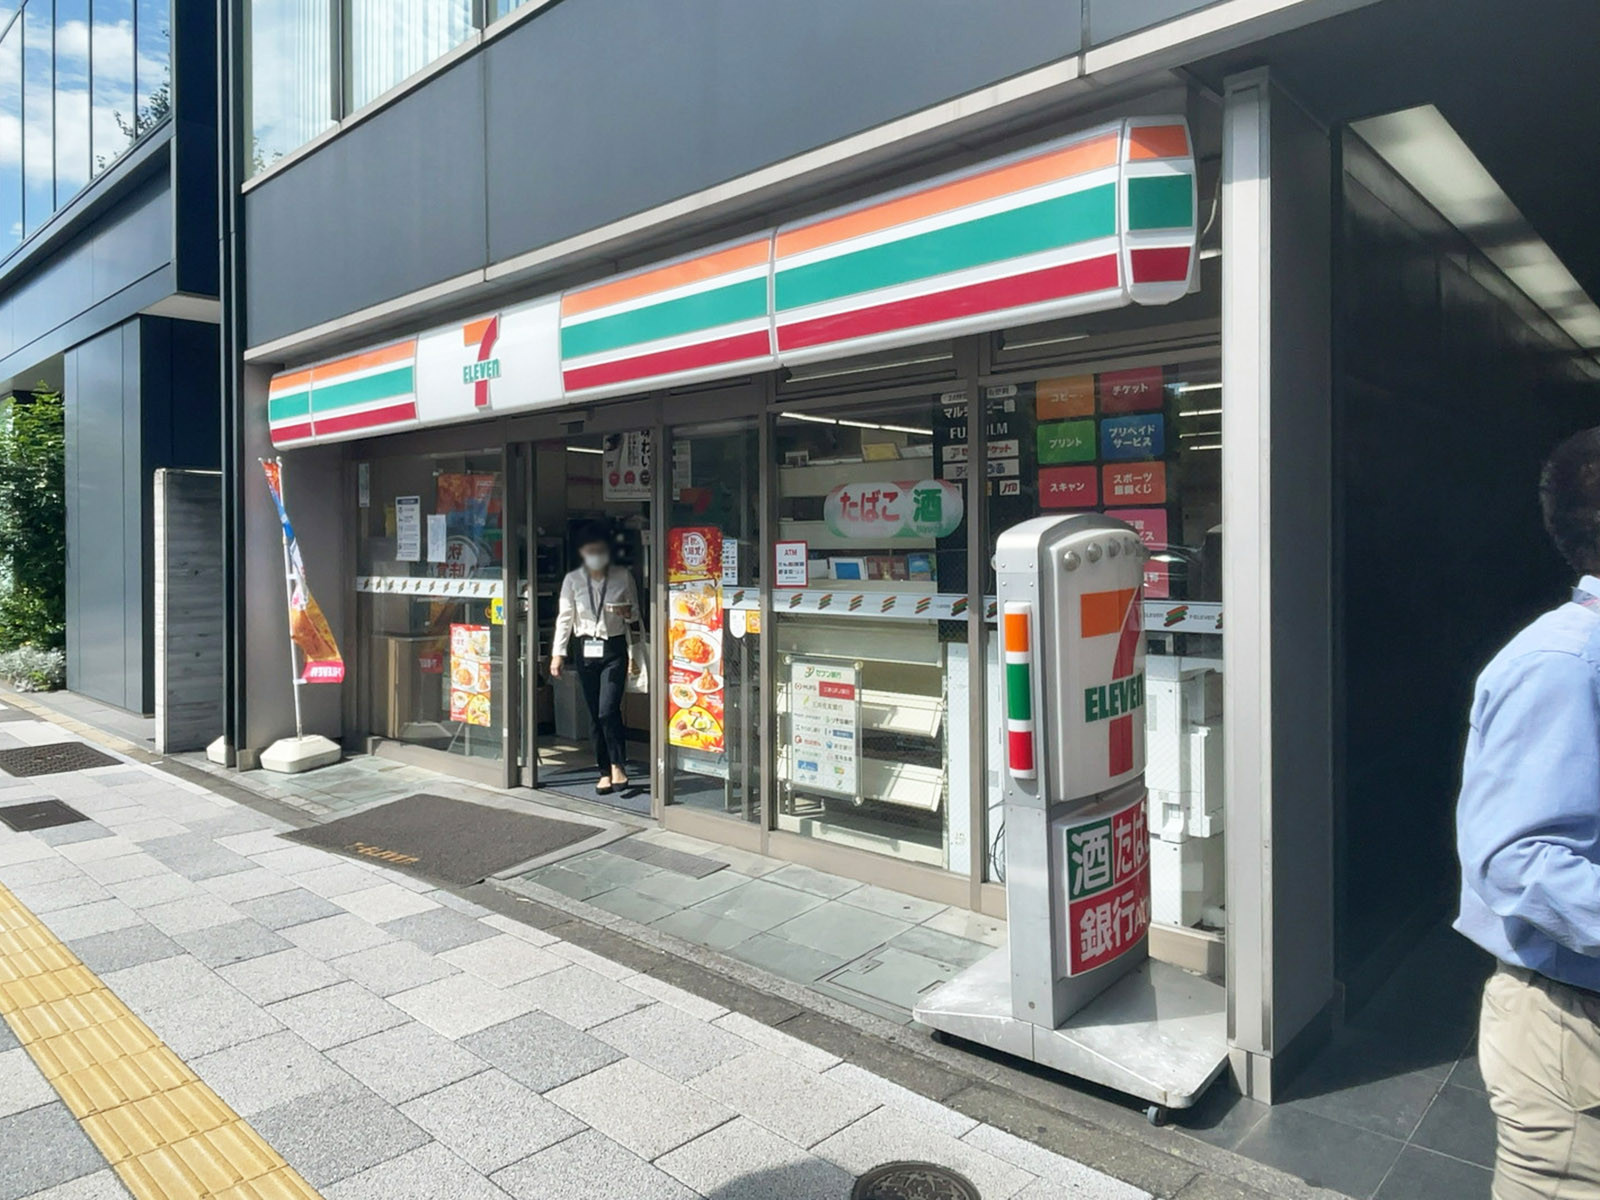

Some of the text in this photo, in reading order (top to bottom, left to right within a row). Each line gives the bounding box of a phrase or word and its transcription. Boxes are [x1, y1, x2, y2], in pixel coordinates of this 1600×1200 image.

[463, 314, 501, 409] 7
[1112, 383, 1149, 396] チケット
[1109, 425, 1156, 438] プリペイド
[1049, 438, 1083, 449] プリント
[1113, 437, 1152, 449] サービス
[1113, 472, 1153, 484] スポーツ
[1050, 482, 1085, 493] スキャン
[839, 488, 943, 522] たばこ 酒
[1080, 586, 1142, 777] 7
[1071, 801, 1150, 896] 酒 たば
